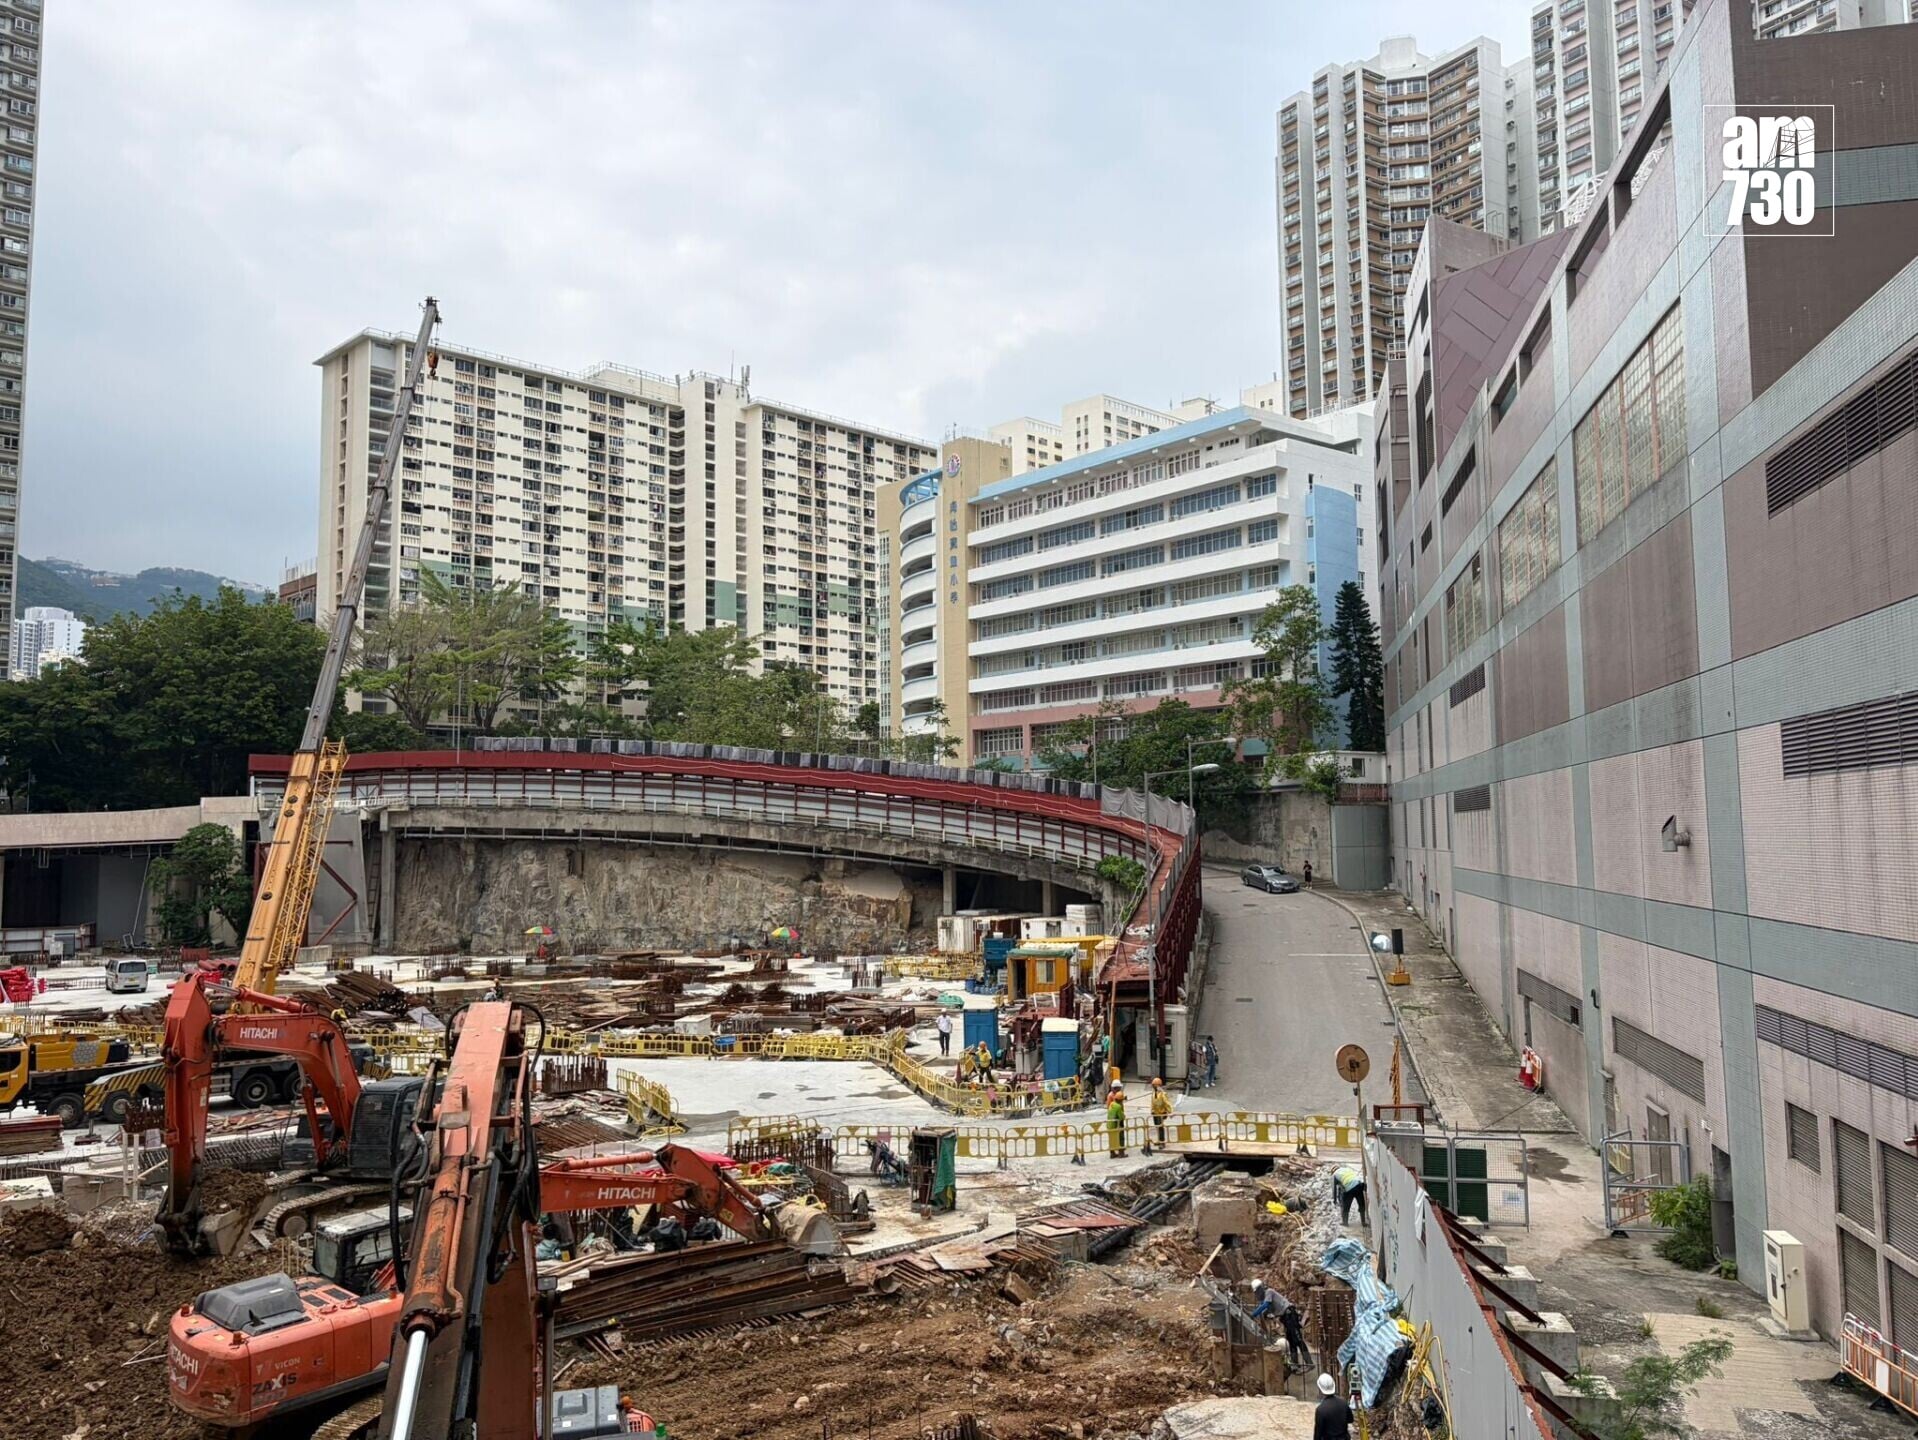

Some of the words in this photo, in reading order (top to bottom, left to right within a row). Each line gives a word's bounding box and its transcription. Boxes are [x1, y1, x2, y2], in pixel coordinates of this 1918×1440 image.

[239, 1026, 278, 1040] HITACHI
[597, 1186, 657, 1200] HITACHI
[252, 1371, 298, 1397] ZAXIS
